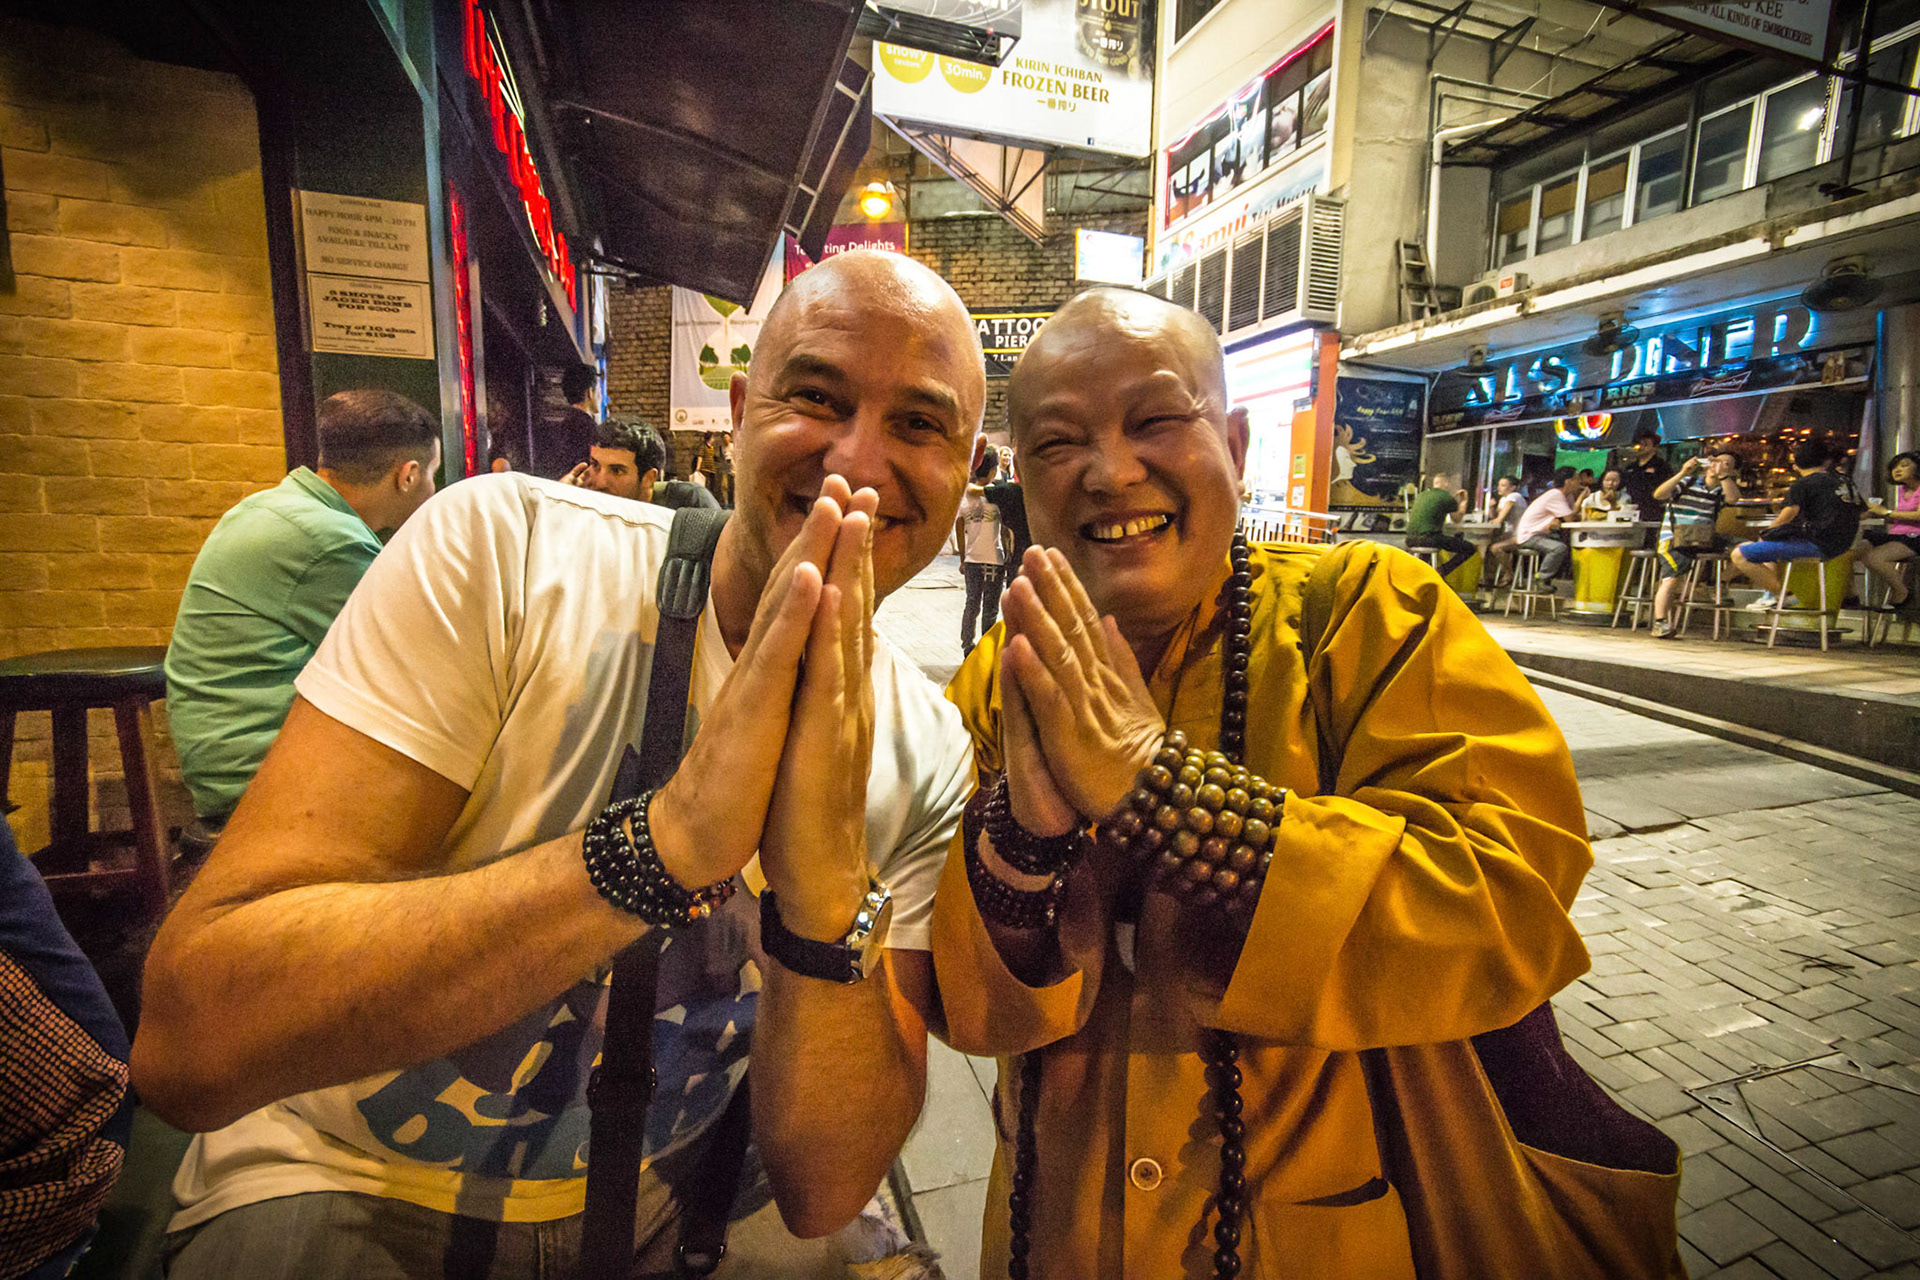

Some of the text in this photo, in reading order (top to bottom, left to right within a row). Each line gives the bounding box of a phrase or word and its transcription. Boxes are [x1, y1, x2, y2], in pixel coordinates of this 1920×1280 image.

[1755, 0, 1783, 19] KEE
[1710, 6, 1725, 20] ALL
[1727, 12, 1750, 28] KINDS
[1751, 18, 1761, 30] OF
[886, 45, 927, 61] snowy
[944, 61, 987, 82] 30min.
[1015, 57, 1103, 83] KIRIN ICHIBAN
[1002, 70, 1110, 104] FROZEN BEER
[305, 207, 335, 219] HAPPY
[336, 211, 362, 222] HOUR
[328, 226, 353, 236] FOOD
[316, 235, 410, 252] AVAILABLE TILL LATE
[848, 239, 896, 252] Delights
[336, 257, 371, 268] SERVICE
[373, 261, 409, 271] CHARGE
[339, 291, 385, 300] SHOTS
[373, 299, 413, 308] BOMB
[336, 303, 365, 311] FOR
[322, 321, 352, 331] Tray
[974, 317, 1047, 336] ATTOO
[995, 334, 1029, 348] PIER
[1608, 306, 1817, 384] DINER
[1606, 382, 1656, 400] RISE
